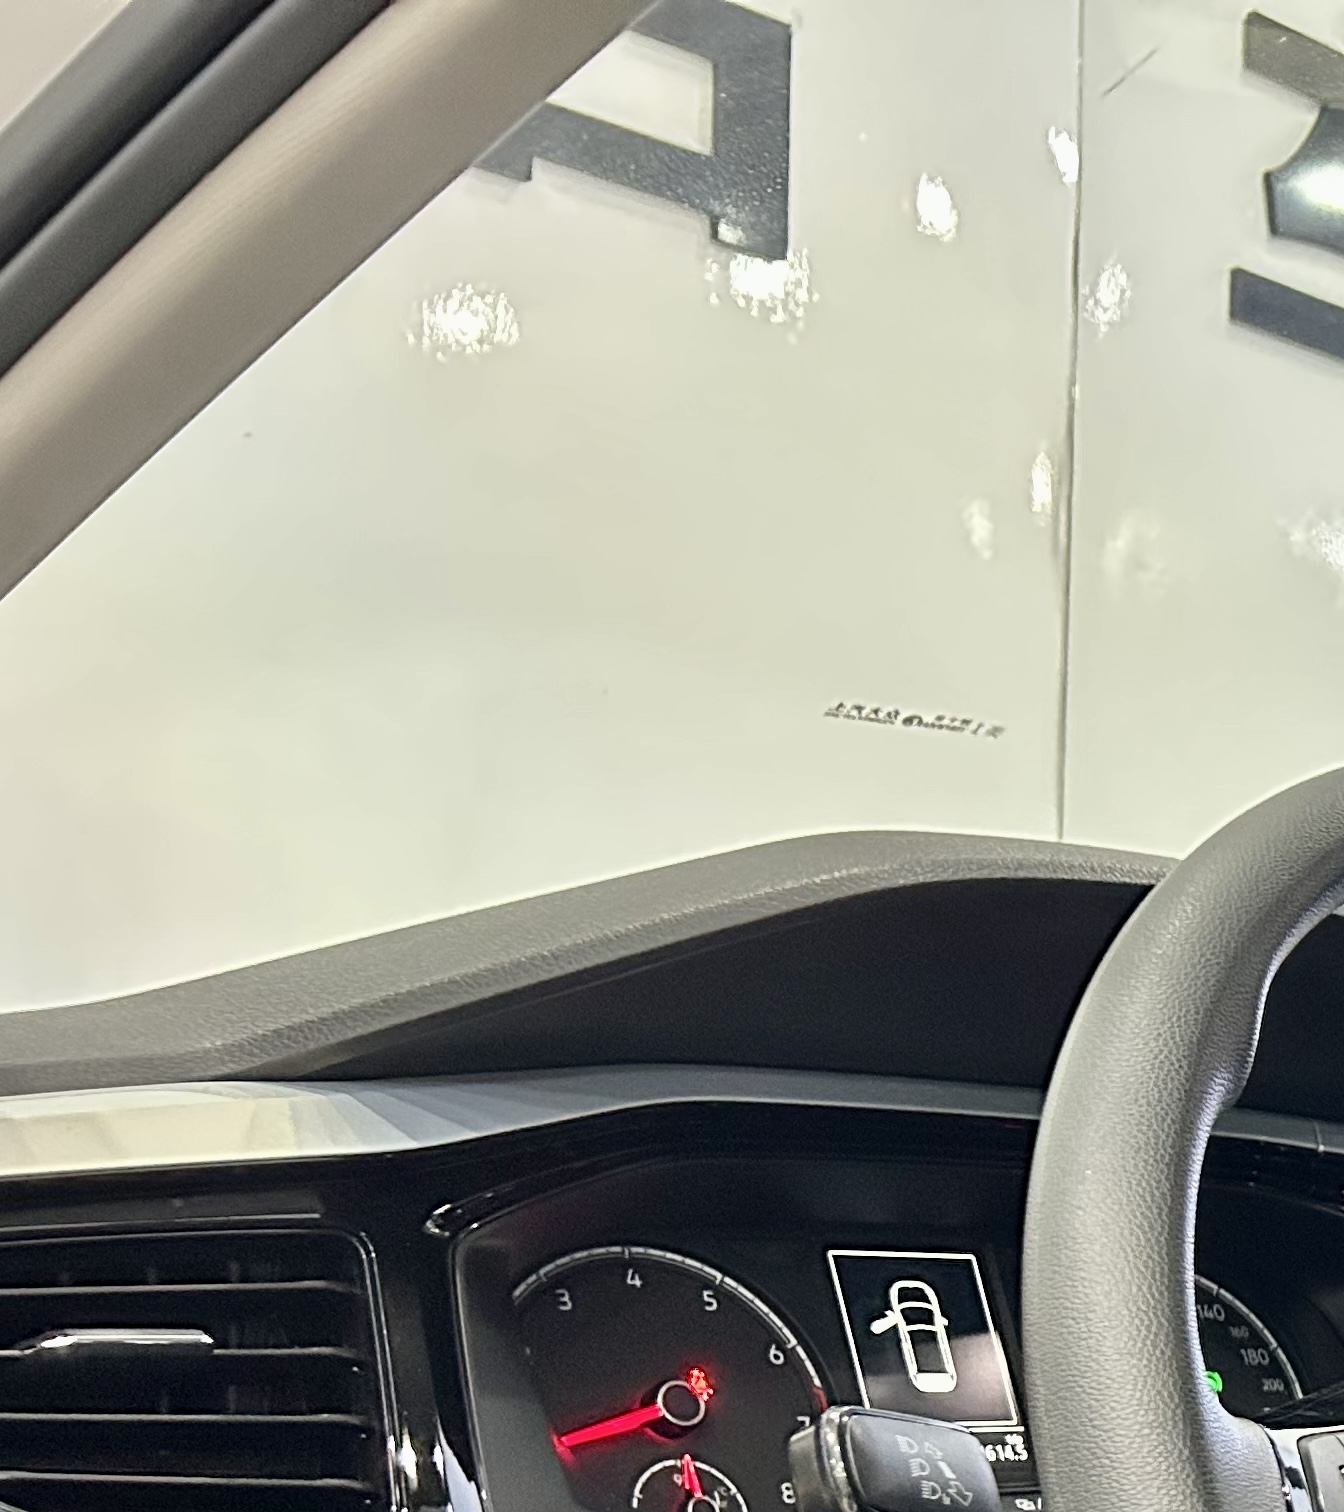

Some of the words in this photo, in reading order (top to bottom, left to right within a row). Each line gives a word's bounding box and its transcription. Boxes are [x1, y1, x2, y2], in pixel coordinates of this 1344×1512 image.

[626, 1268, 643, 1288] 4
[554, 1288, 573, 1311] 3
[702, 1289, 718, 1311] 5
[1197, 1303, 1226, 1322] 140
[768, 1344, 785, 1366] 6
[1240, 1348, 1270, 1367] 180
[1261, 1377, 1285, 1392] 200
[780, 1481, 796, 1505] 8
